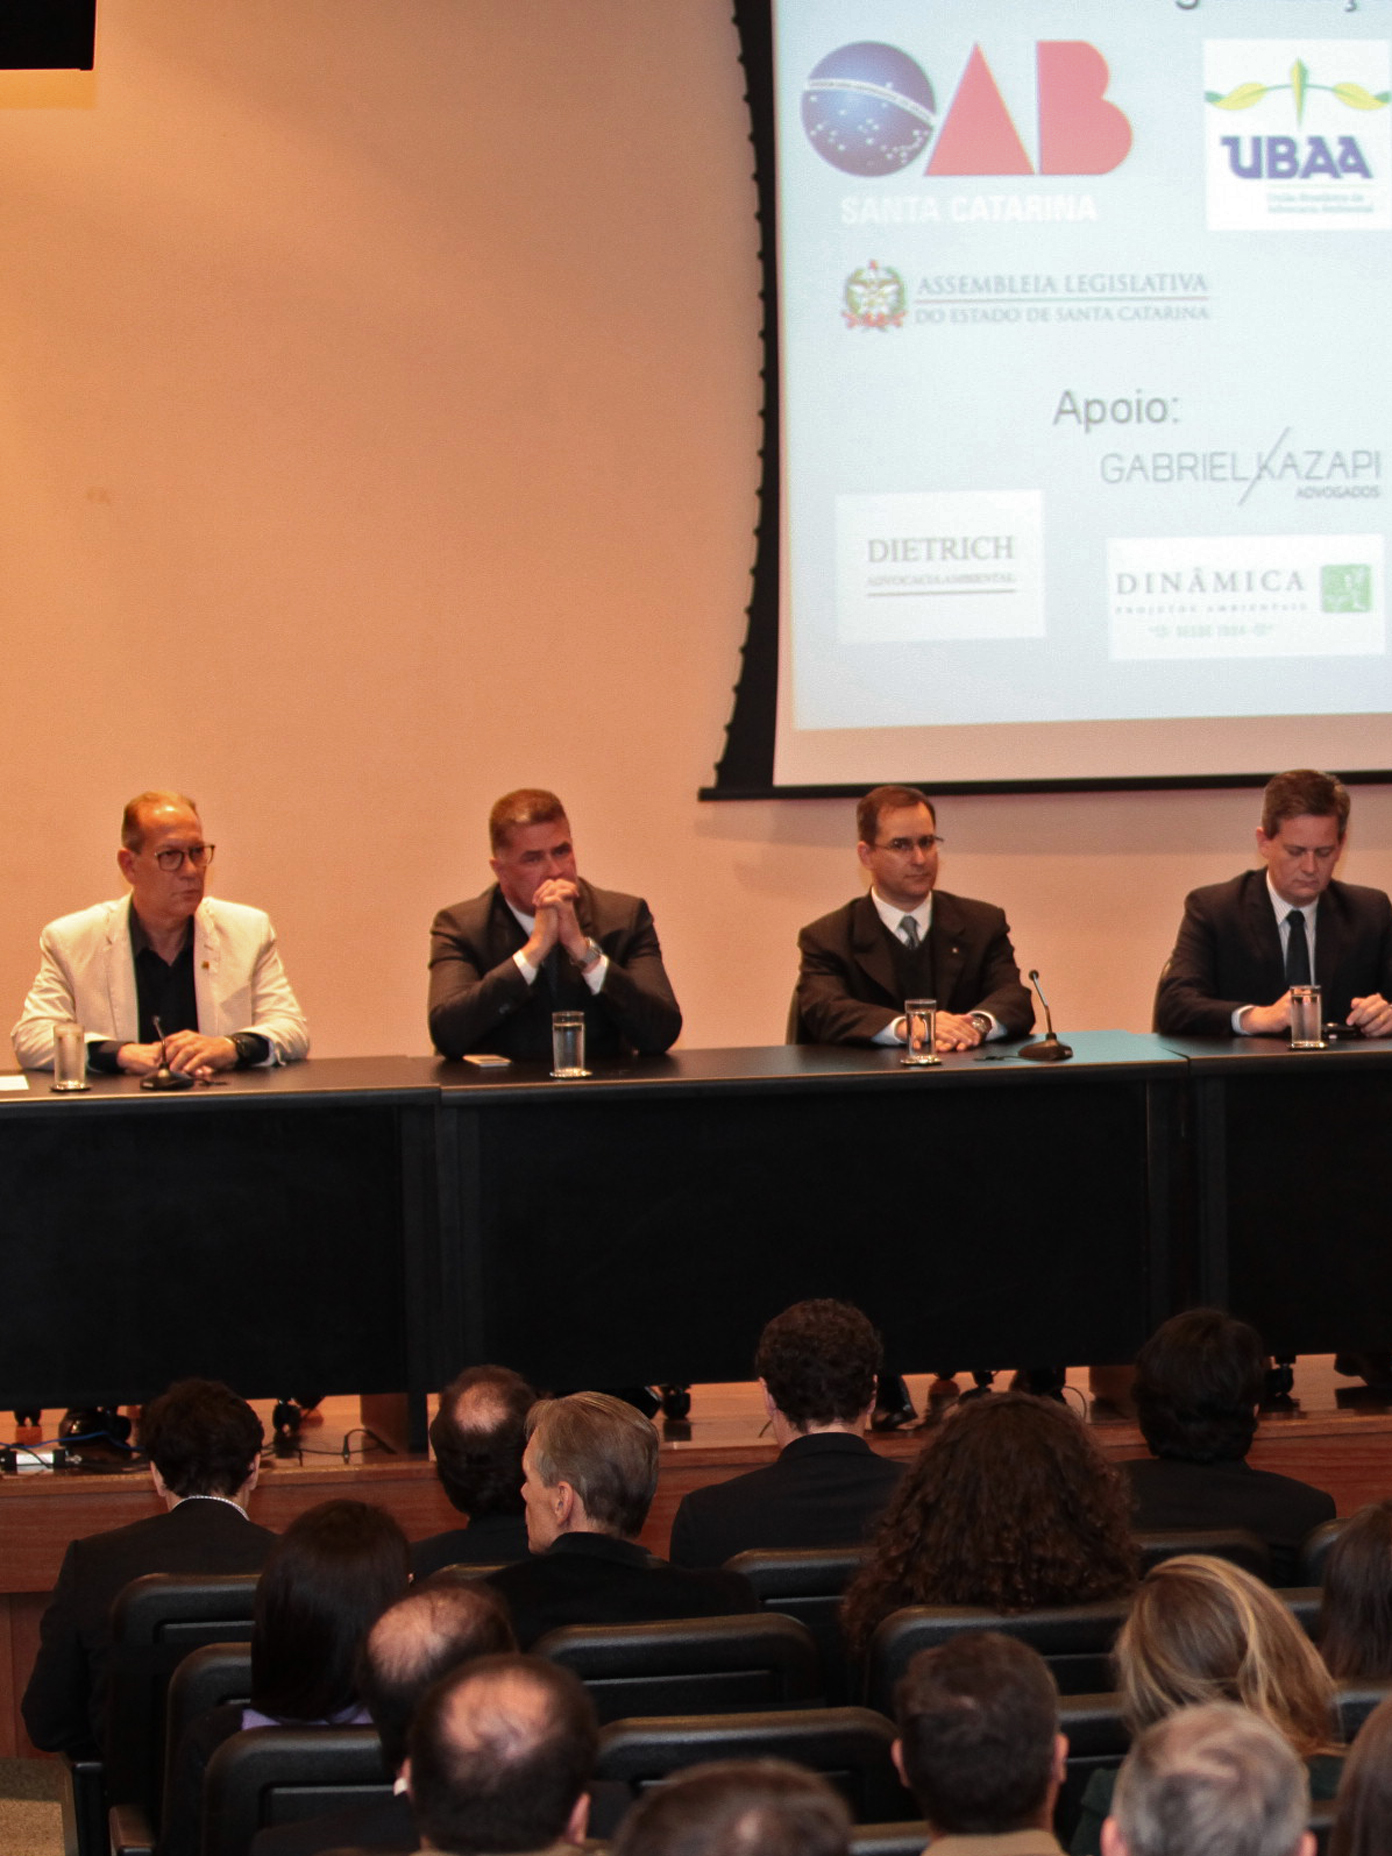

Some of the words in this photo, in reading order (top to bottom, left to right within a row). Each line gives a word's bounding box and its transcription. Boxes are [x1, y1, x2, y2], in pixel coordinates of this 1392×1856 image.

[1219, 136, 1374, 179] UBAA
[841, 197, 940, 225] SANTA
[951, 194, 1098, 223] CATARINA
[917, 274, 1057, 295] ASSEMBLEIA
[1064, 272, 1209, 293] LEGISLATIVA
[916, 307, 944, 325] DO
[950, 307, 1020, 324] ESTADO
[1027, 306, 1051, 323] DE
[1056, 305, 1114, 323] SANTA
[1117, 303, 1210, 322] CATARINA
[1053, 389, 1178, 434] Apoio:
[1296, 484, 1381, 499] ADVOGADOS
[867, 535, 1015, 564] DIETRICH
[1116, 565, 1306, 595] DINÂMICA
